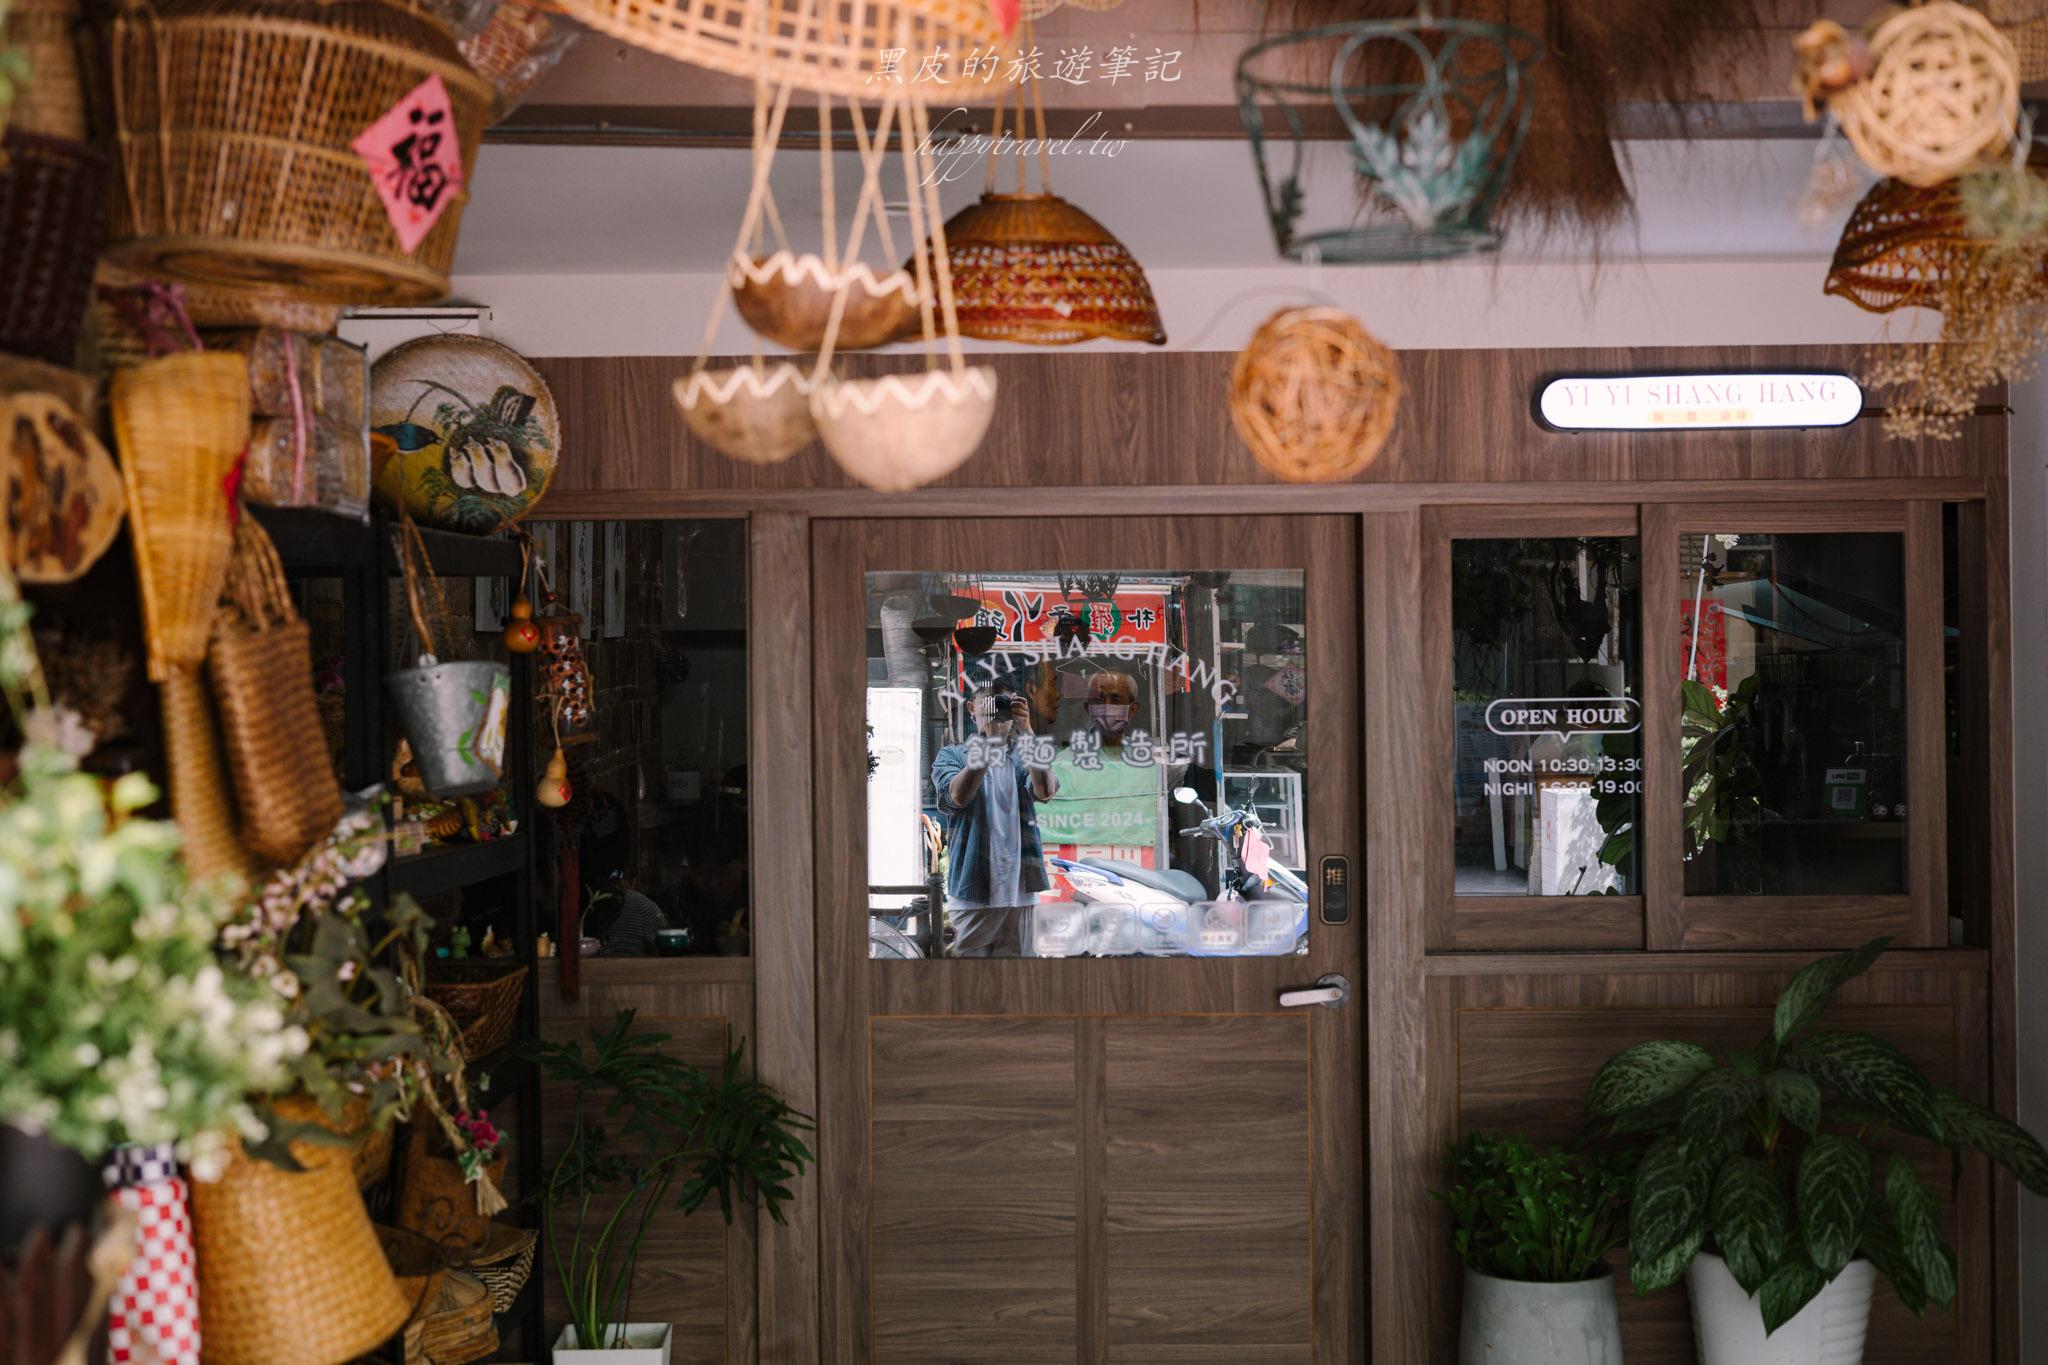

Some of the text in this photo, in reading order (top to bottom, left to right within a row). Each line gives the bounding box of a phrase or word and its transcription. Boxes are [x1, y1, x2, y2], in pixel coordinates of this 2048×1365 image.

[1565, 380, 1837, 406] YI YI SHANG HANG
[976, 647, 1016, 679] YI
[1022, 633, 1137, 666] SHANG
[1143, 641, 1238, 706] HANG
[1501, 708, 1628, 725] OPEN HOUR
[965, 730, 1207, 770] 飯麵製造所
[1484, 759, 1533, 773] NOON
[1326, 867, 1345, 886] 推
